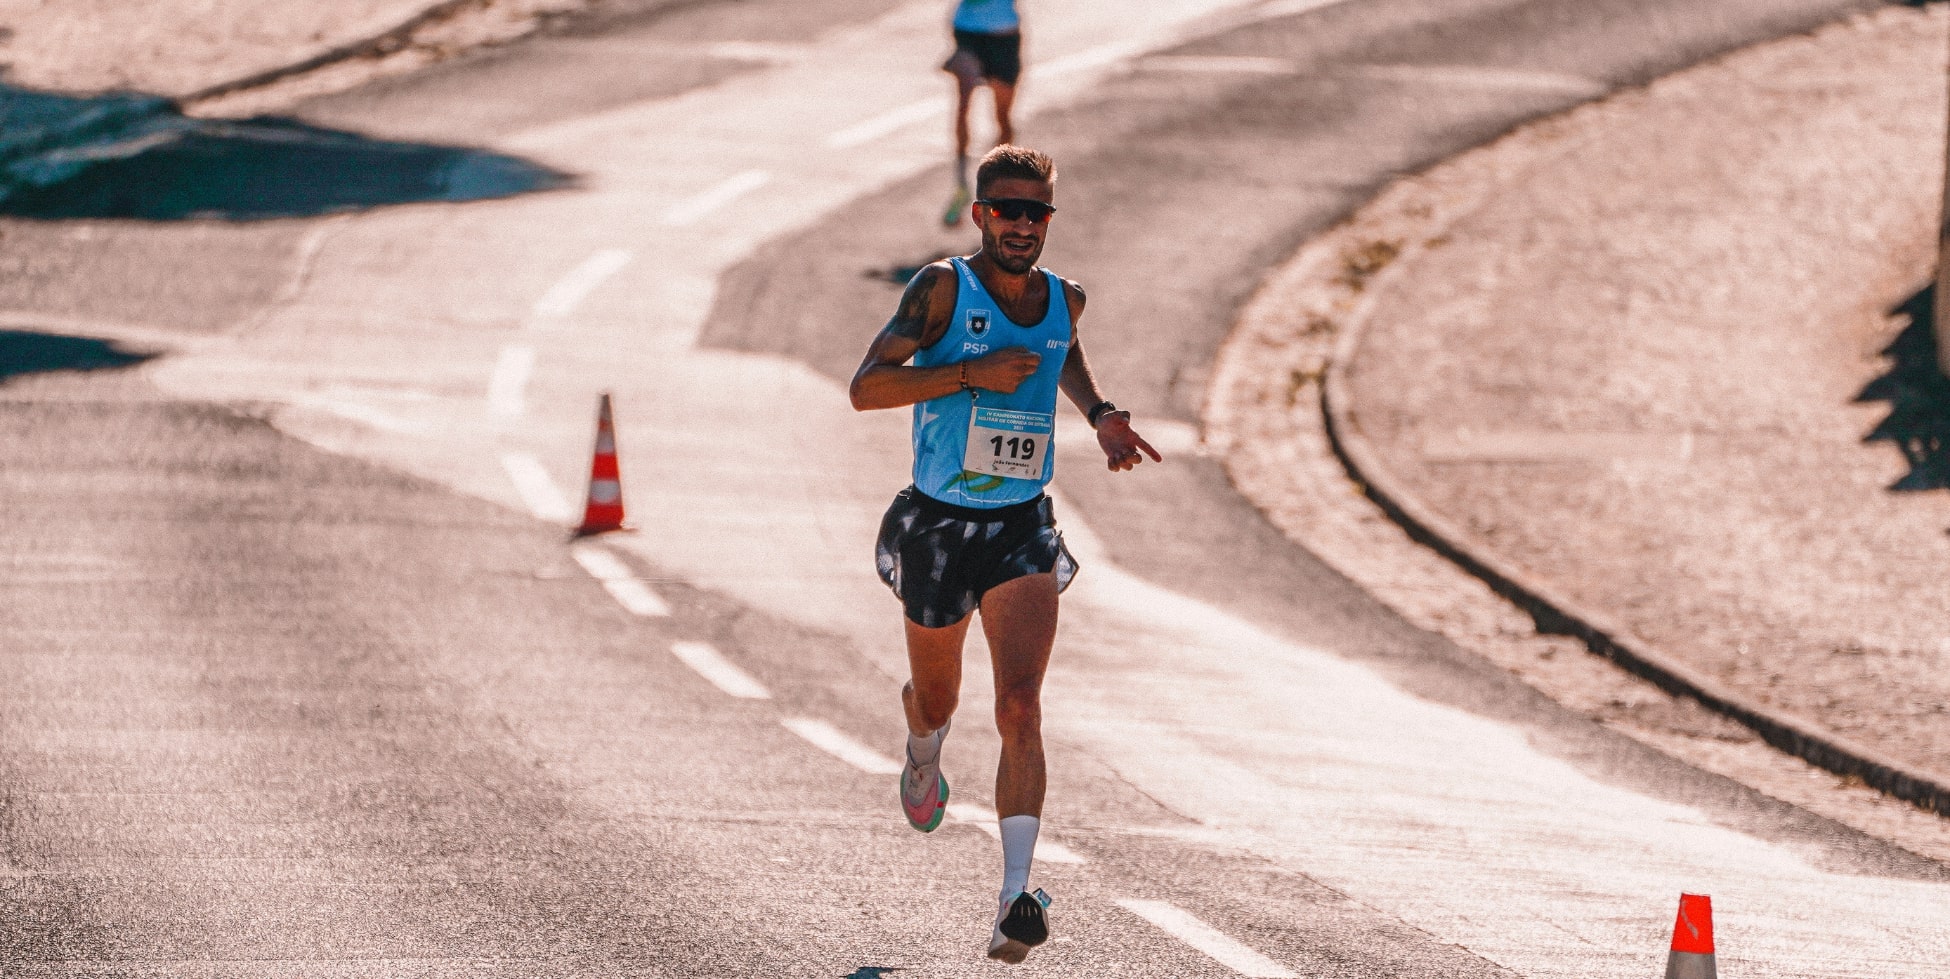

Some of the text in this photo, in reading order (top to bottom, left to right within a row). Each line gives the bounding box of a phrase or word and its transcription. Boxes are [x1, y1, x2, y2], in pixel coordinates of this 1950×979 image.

[963, 342, 989, 354] PSP
[993, 412, 1026, 420] CAMPEONATO
[990, 435, 1036, 460] 119
